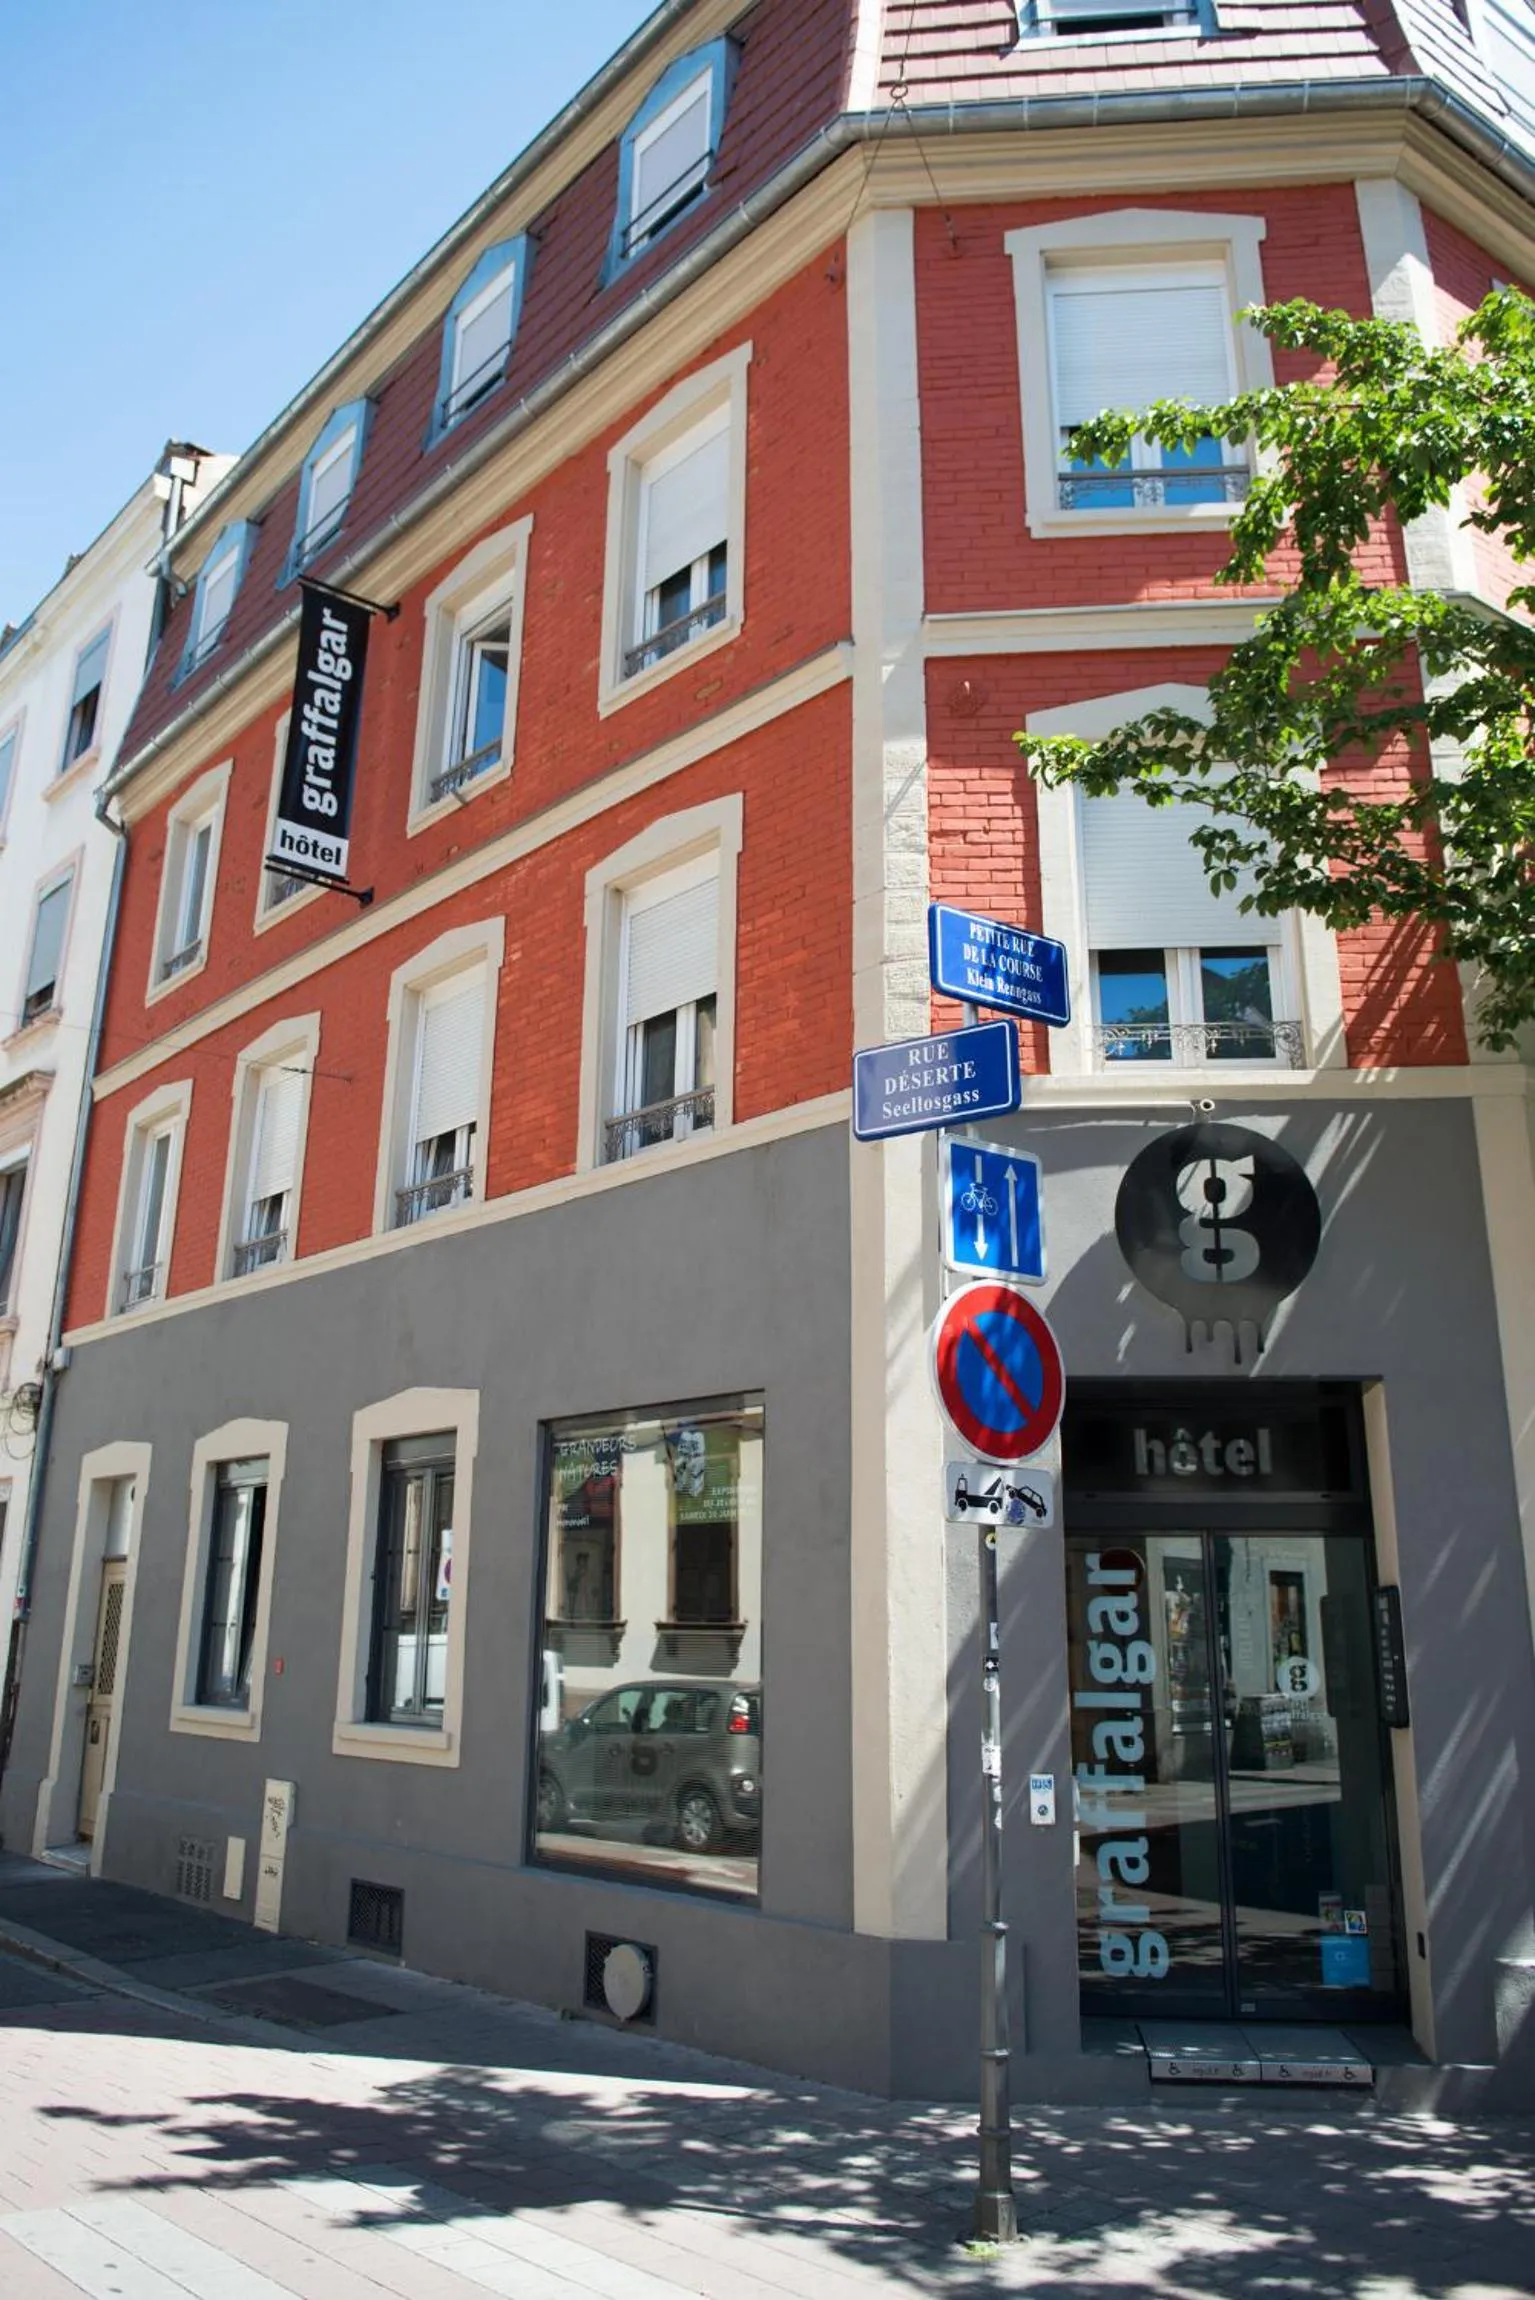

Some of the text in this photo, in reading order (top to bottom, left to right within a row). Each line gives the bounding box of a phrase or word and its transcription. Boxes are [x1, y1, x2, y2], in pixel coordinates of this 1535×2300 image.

[301, 608, 353, 818] graffalgar
[279, 829, 342, 866] hôtel
[969, 921, 1035, 958] PETITE RUE
[963, 942, 1044, 983] DE LA COURSE
[966, 967, 994, 992] Klein
[908, 1042, 949, 1067] RUE
[884, 1060, 977, 1096] DÉSERTE
[881, 1088, 981, 1120] Seellosgass
[1133, 1426, 1274, 1477] hôtel
[1073, 1552, 1171, 1980] graffalgar
